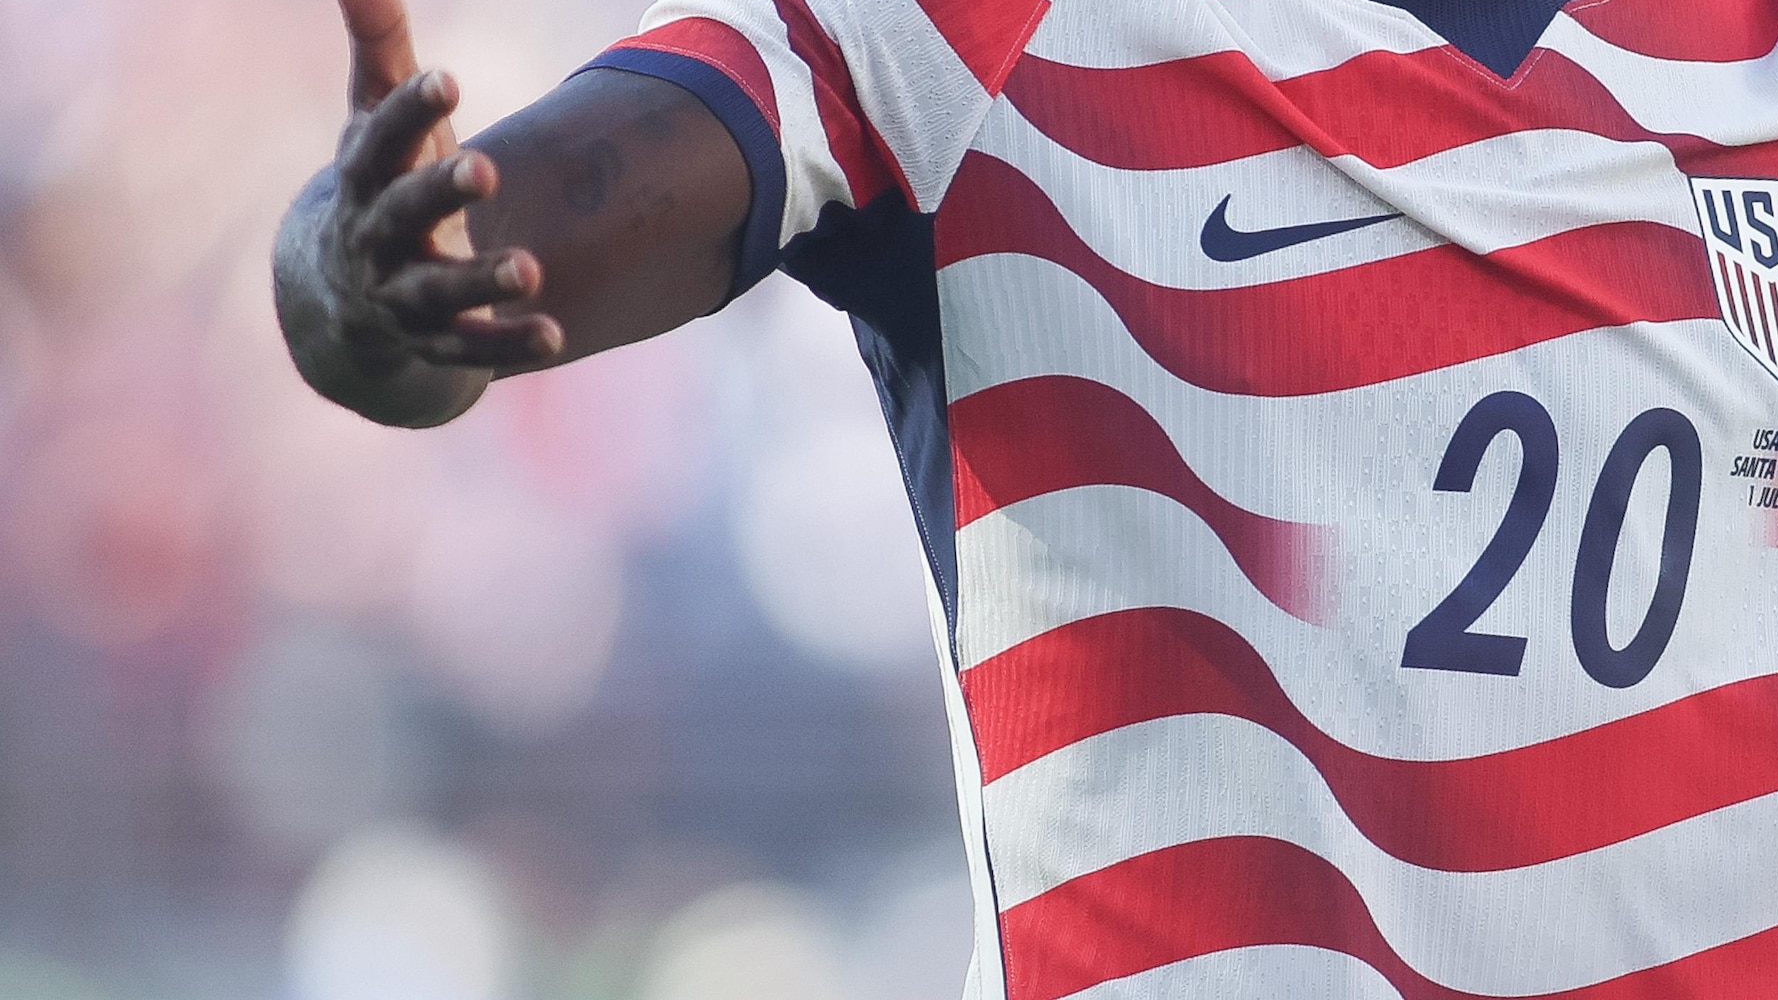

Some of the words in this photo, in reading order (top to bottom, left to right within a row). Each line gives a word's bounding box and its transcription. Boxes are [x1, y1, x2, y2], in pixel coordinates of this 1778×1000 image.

[1730, 456, 1776, 480] SANTA
[1748, 485, 1755, 506] 1
[1401, 390, 1702, 689] 20
